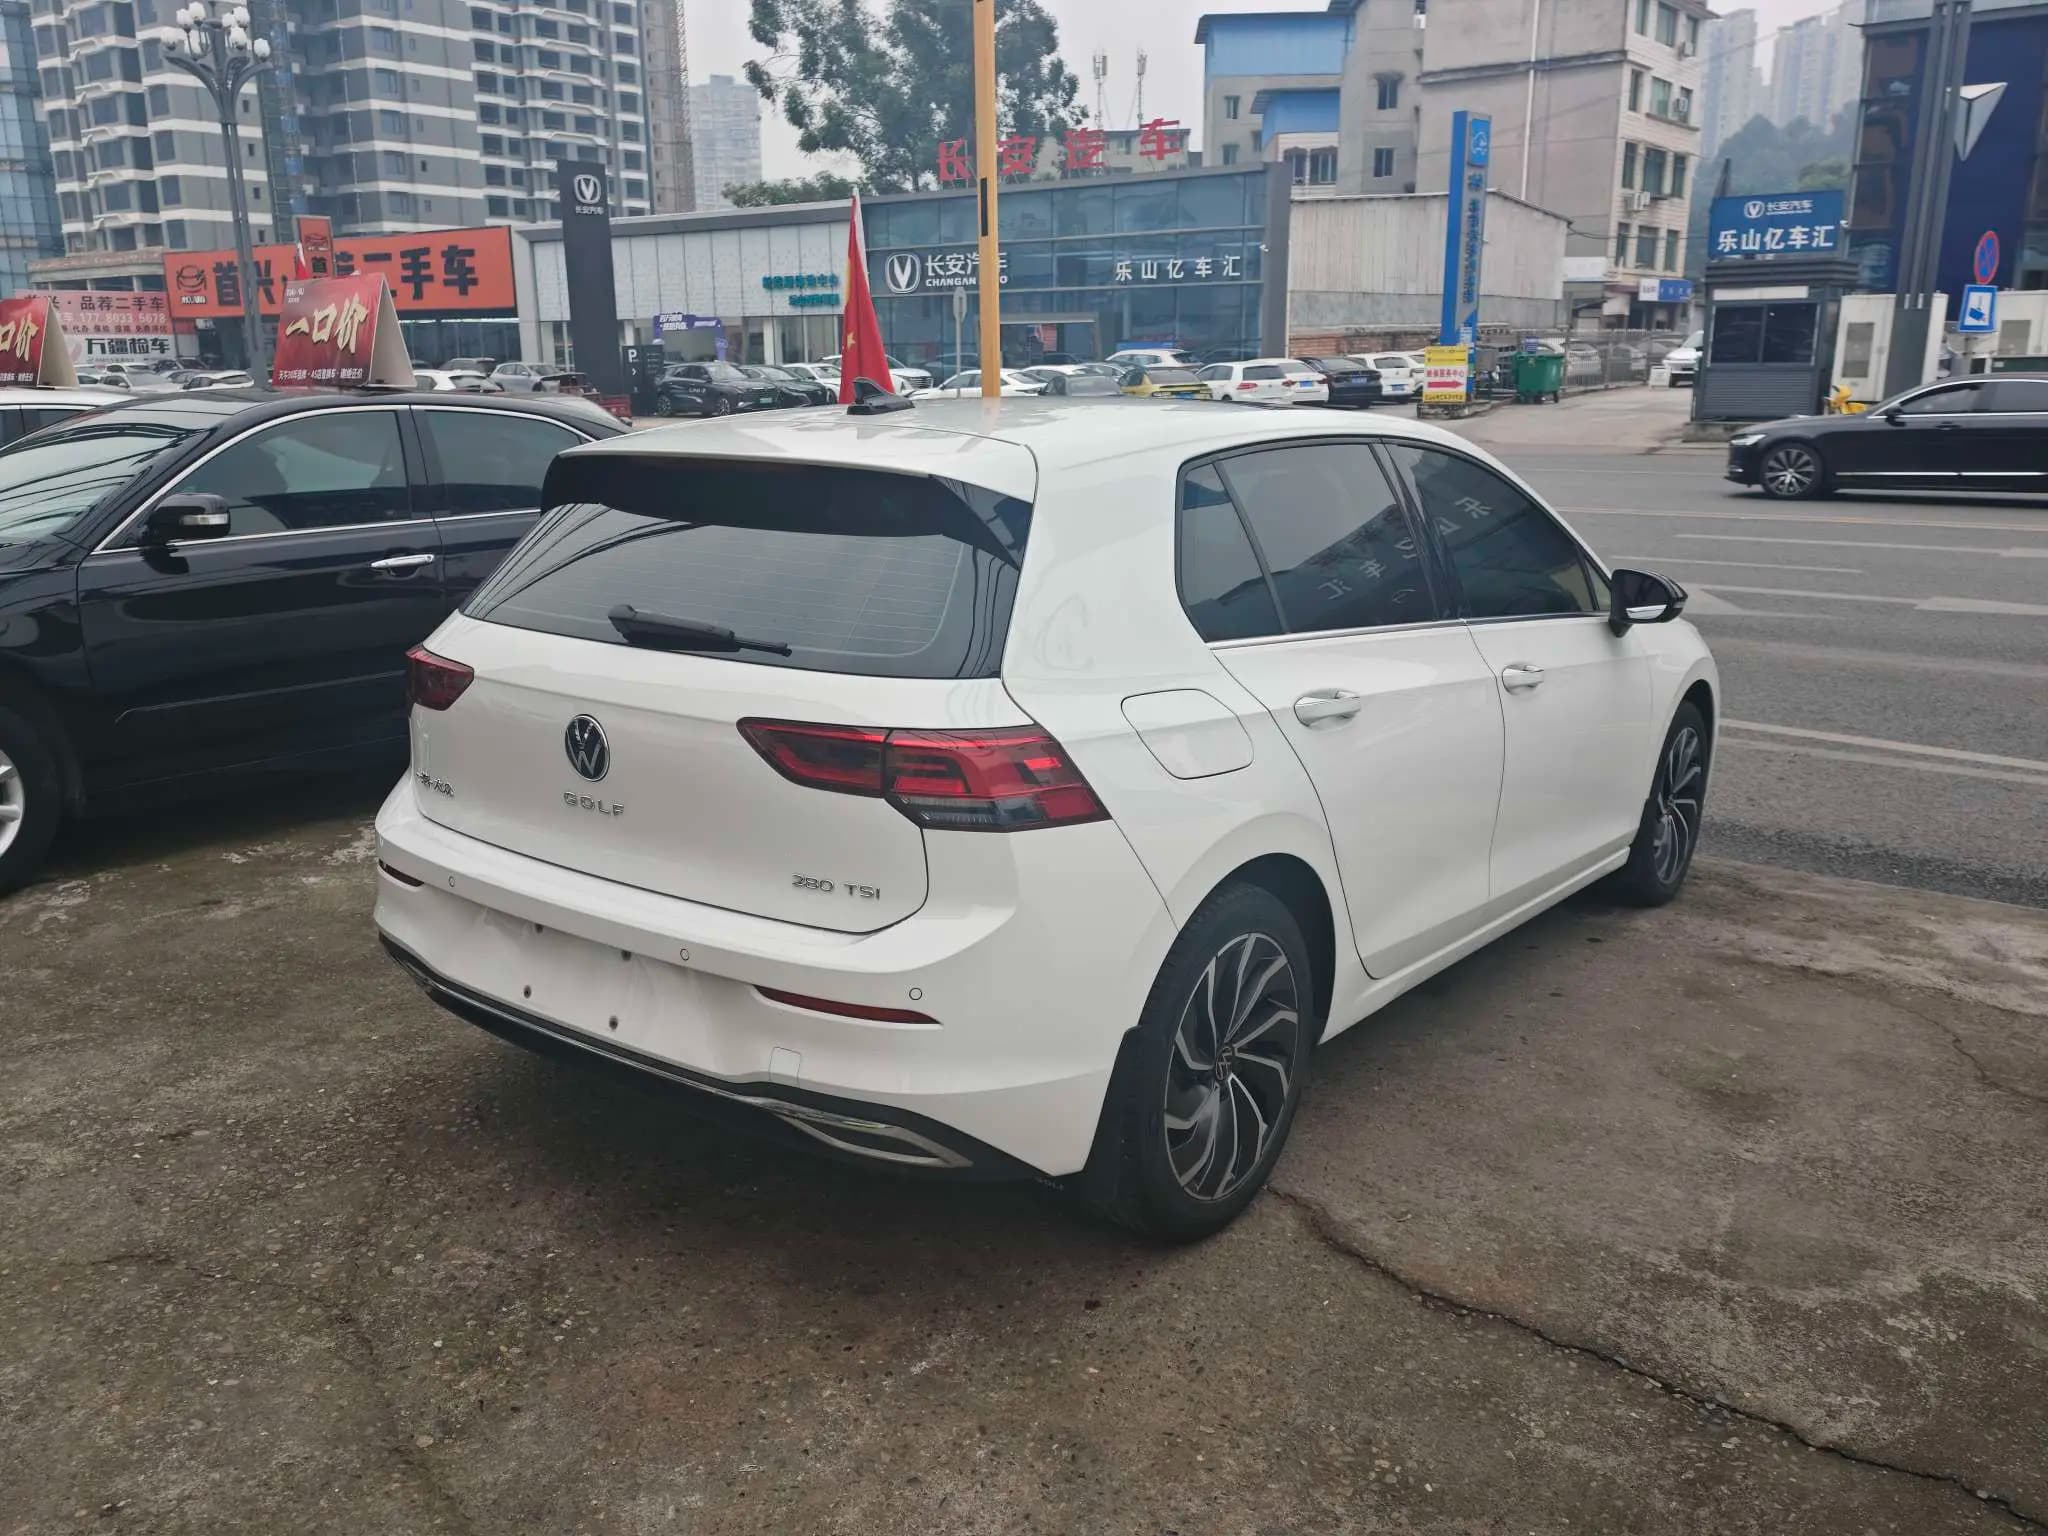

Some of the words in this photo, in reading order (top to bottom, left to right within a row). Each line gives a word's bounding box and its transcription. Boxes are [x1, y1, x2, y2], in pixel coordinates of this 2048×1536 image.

[939, 118, 1181, 181] 长安汽车
[1717, 225, 1835, 252] 乐山亿车汇
[1115, 255, 1241, 281] 乐山亿车汇
[925, 277, 977, 287] CHANGAN
[284, 291, 369, 355] 一口价
[85, 338, 170, 355] 万疆检车
[563, 791, 625, 817] GOLF
[791, 872, 834, 892] 280
[843, 882, 881, 901] TSI
